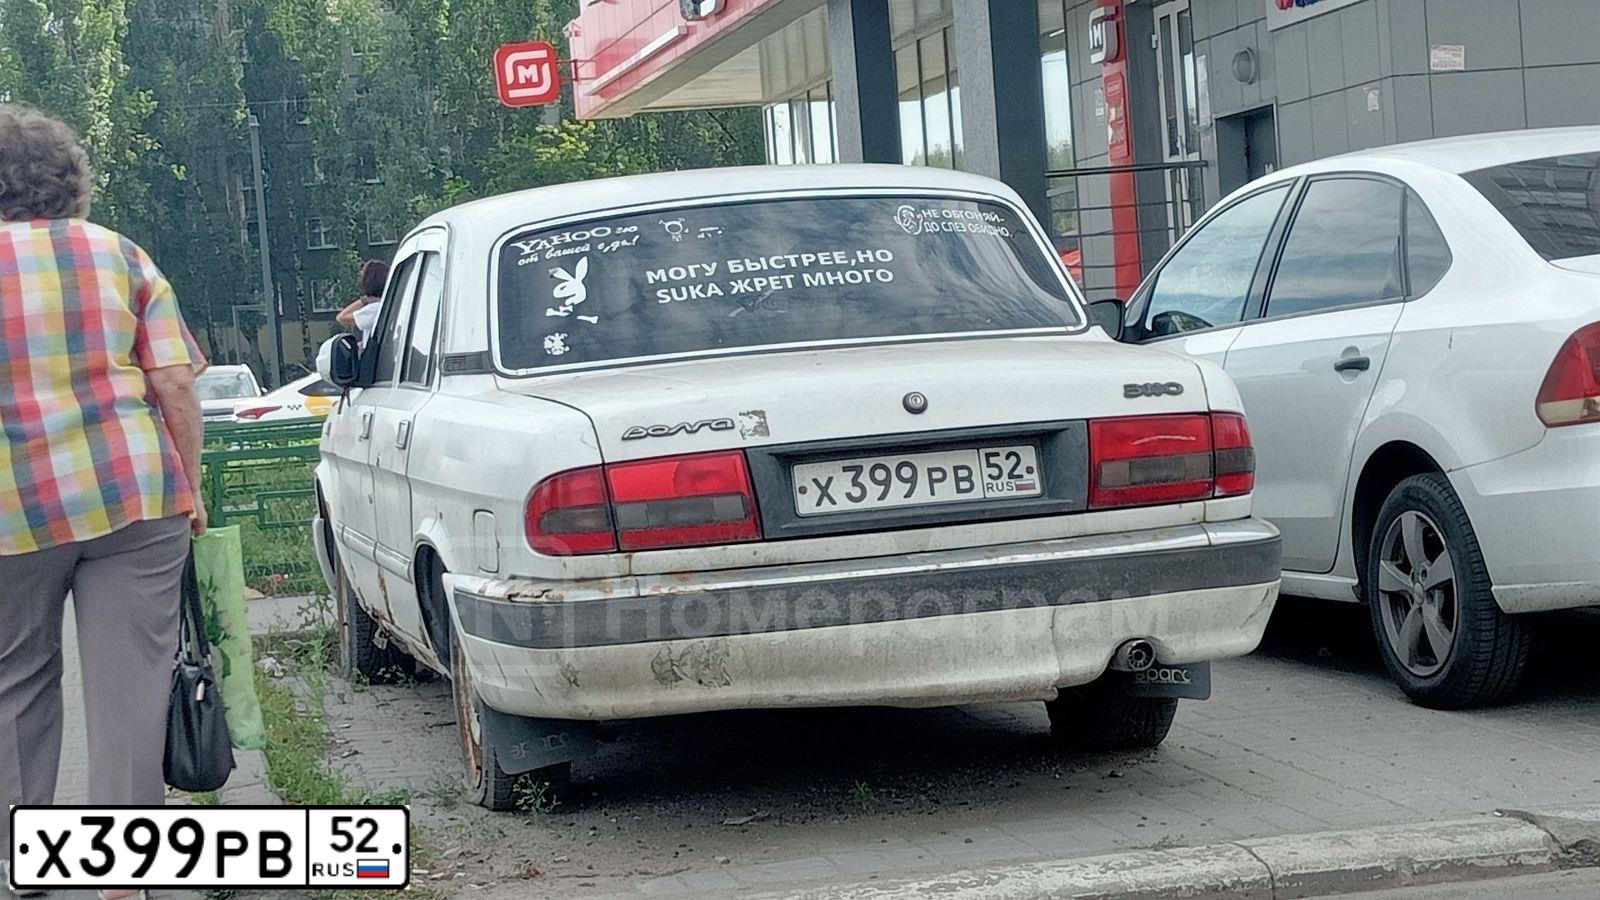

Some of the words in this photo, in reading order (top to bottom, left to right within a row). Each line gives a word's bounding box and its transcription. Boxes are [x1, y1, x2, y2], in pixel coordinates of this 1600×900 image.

[921, 209, 940, 219] НЕ
[924, 221, 940, 234] ДО
[646, 262, 718, 285] МОГУ
[656, 282, 725, 304] SUKA
[729, 274, 795, 295] ЖРЕТ
[802, 269, 893, 288] МНОГО
[984, 451, 1024, 481] 52
[986, 481, 1014, 493] RUS
